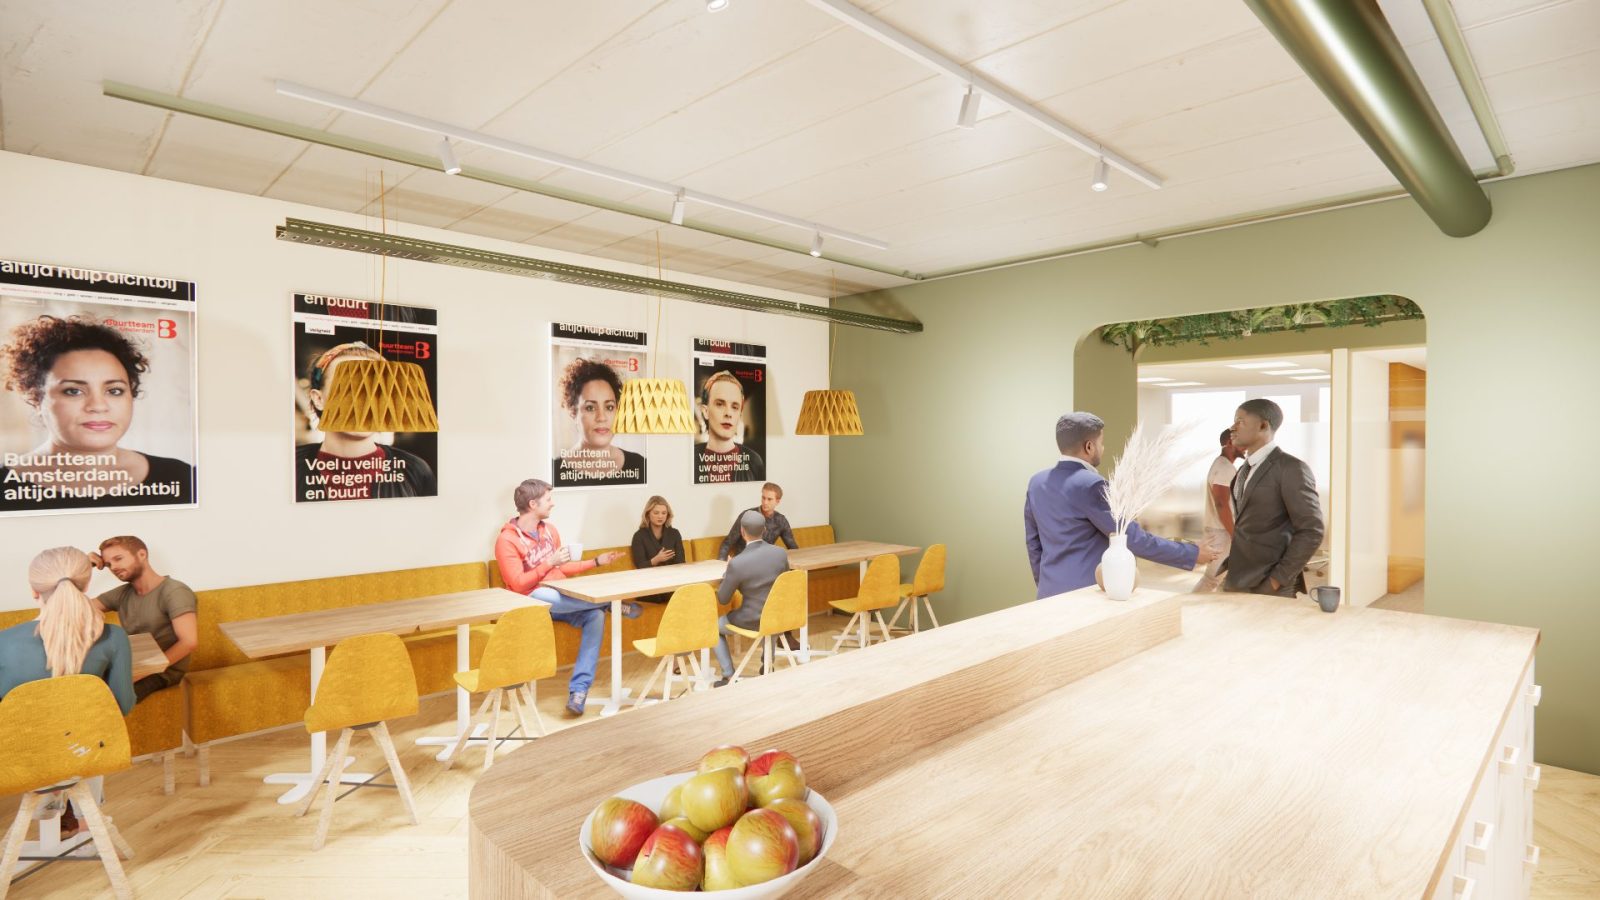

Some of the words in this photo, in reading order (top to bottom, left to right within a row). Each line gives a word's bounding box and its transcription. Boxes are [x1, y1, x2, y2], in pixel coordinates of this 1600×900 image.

[304, 294, 324, 306] en
[4, 452, 117, 467] Buurtteam
[560, 448, 611, 458] Buurtteam
[699, 453, 716, 462] Voel
[723, 452, 743, 463] veilig
[743, 452, 750, 461] in
[305, 458, 339, 471] Voel
[342, 460, 351, 470] u
[354, 457, 391, 472] veilig
[393, 457, 406, 469] in
[560, 459, 618, 469] Amsterdam,
[699, 464, 711, 473] uw
[712, 463, 733, 474] eigen
[733, 462, 750, 471] huis
[3, 468, 134, 483] Amsterdam,
[305, 474, 330, 486] uw
[331, 470, 373, 487] eigen
[375, 470, 405, 483] huis
[560, 470, 584, 482] altijd
[585, 469, 606, 480] hulp
[606, 468, 640, 480] dichtbij
[699, 474, 709, 482] en
[710, 473, 731, 482] buurt
[4, 485, 57, 502] altijd
[61, 484, 107, 500] hulp
[109, 481, 181, 497] dichtbij
[305, 489, 325, 500] en
[328, 486, 369, 499] buurt
